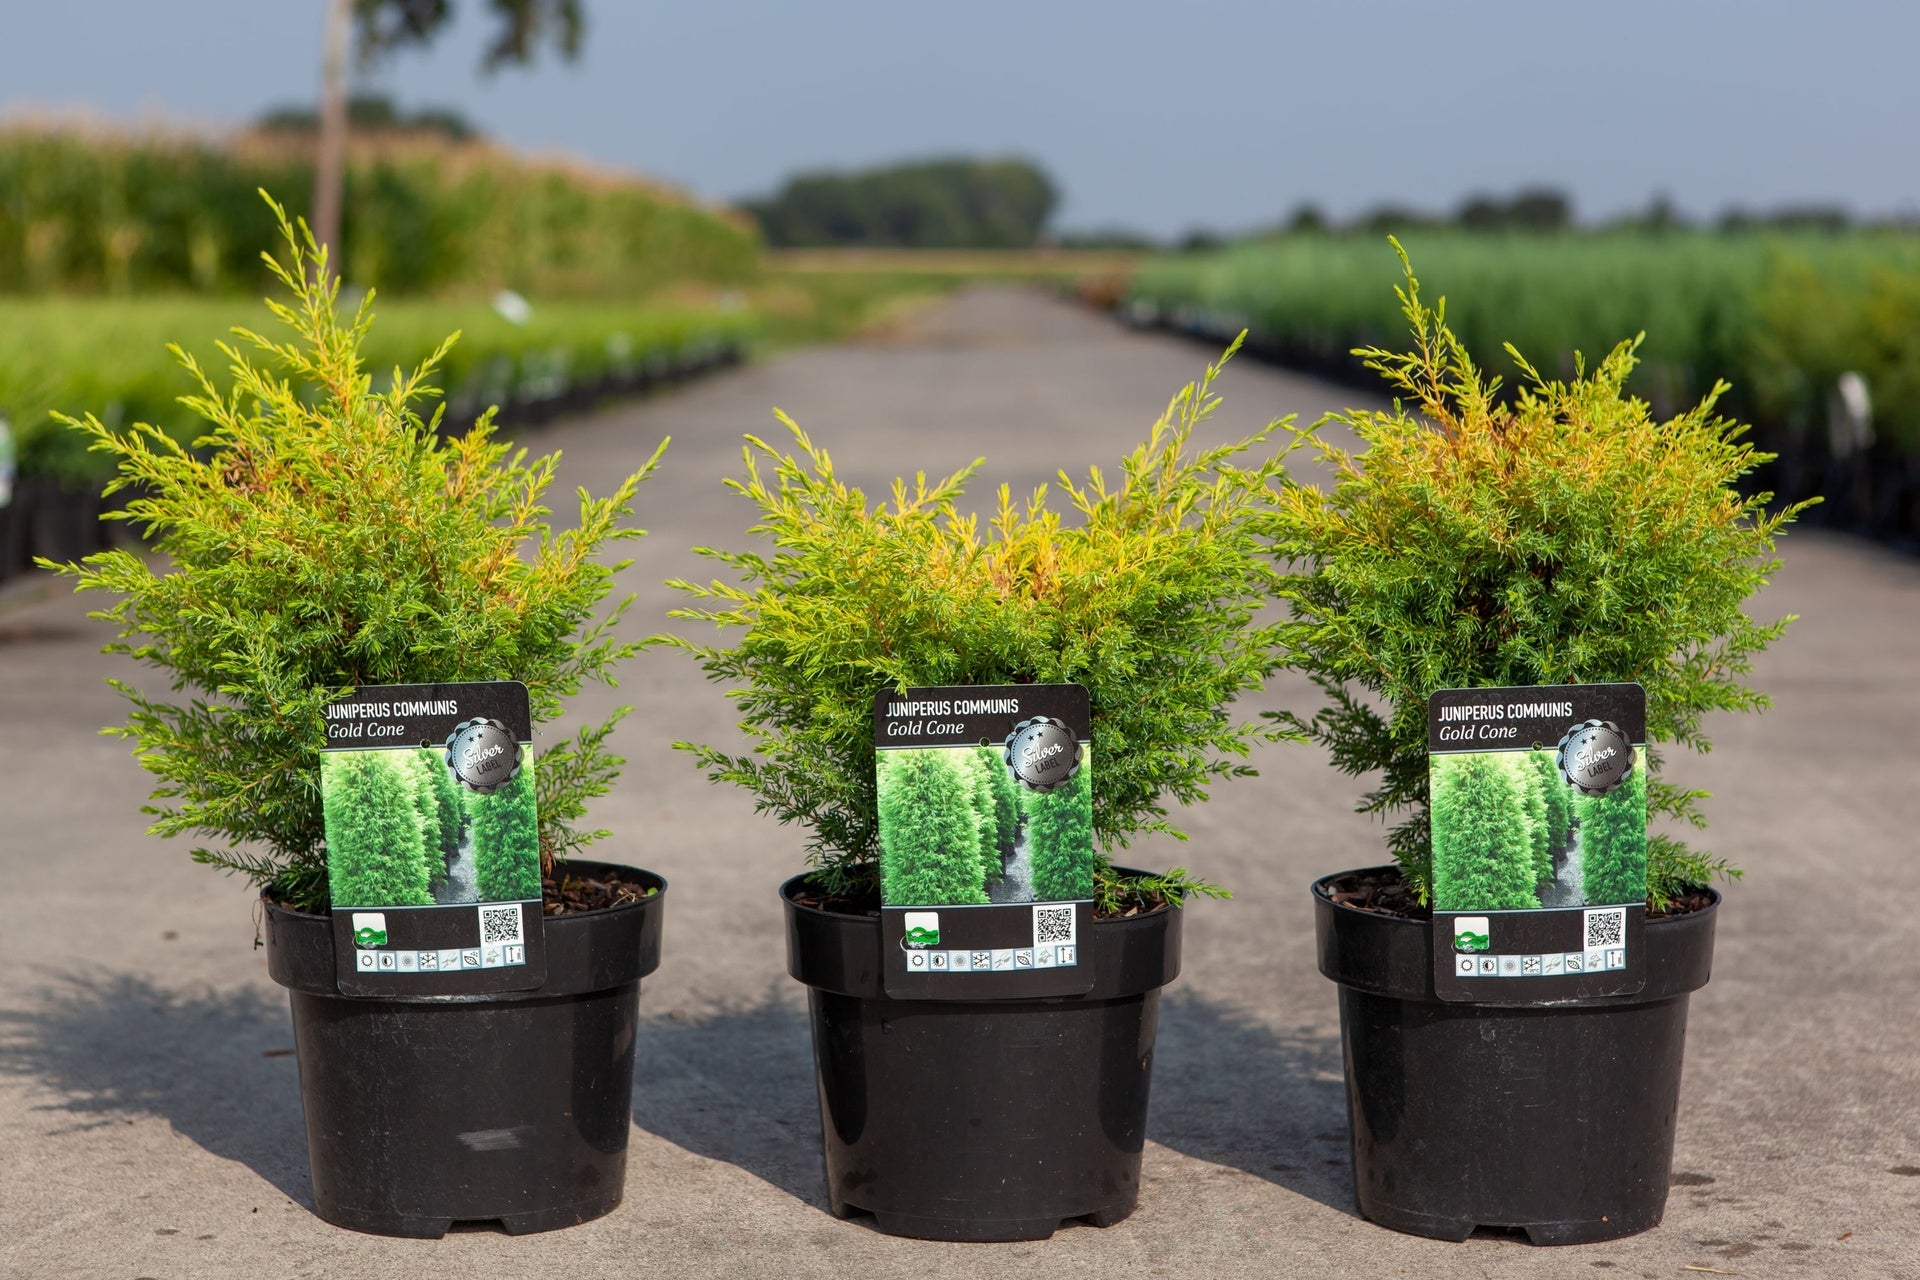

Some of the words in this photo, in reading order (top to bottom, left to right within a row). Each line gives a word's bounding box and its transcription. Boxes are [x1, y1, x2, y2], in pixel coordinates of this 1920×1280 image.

[326, 703, 390, 720] JUNIPERUS
[393, 700, 458, 717] COMMUNIS
[886, 701, 951, 717] JUNIPERUS
[954, 698, 1019, 716] COMMUNIS
[1438, 704, 1504, 722] JUNIPERUS
[1507, 702, 1573, 719] COMMUNIS
[328, 722, 362, 739] Gold
[367, 722, 405, 737] Cone
[887, 720, 922, 736] Gold
[926, 720, 964, 735] Cone
[1439, 725, 1474, 741] Gold
[1479, 725, 1517, 740] Cone
[462, 743, 504, 769] Silver
[1022, 741, 1063, 767] Silver
[1574, 744, 1617, 771] Silver
[476, 760, 501, 775] LABEL
[1034, 758, 1060, 774] LABEL
[1587, 762, 1613, 778] LABEL
